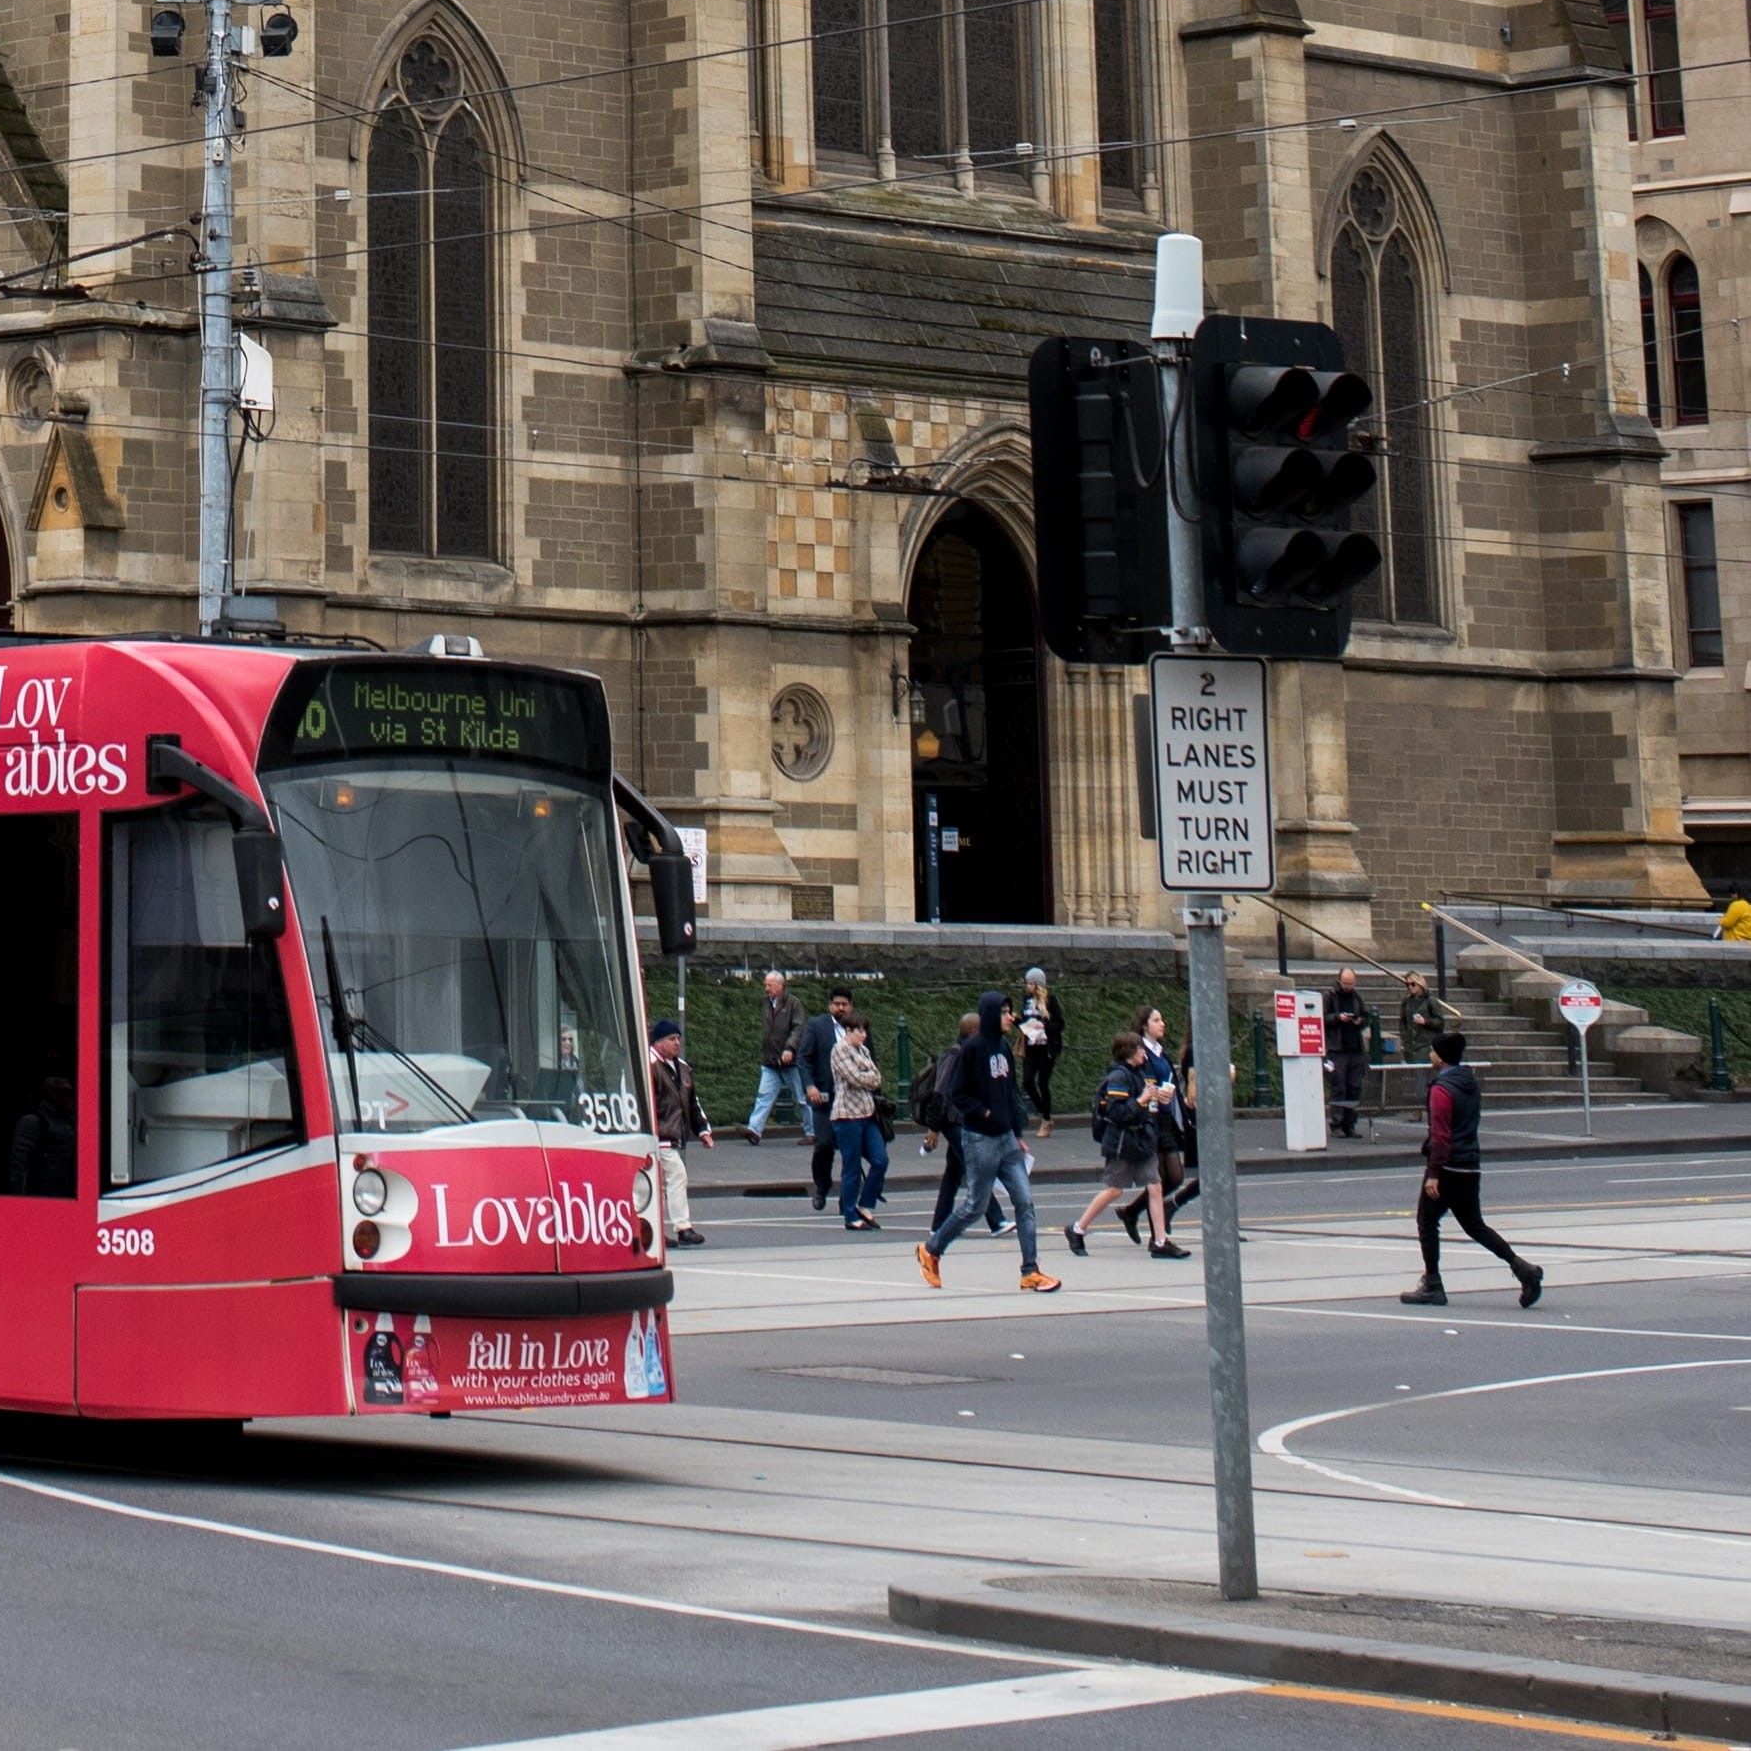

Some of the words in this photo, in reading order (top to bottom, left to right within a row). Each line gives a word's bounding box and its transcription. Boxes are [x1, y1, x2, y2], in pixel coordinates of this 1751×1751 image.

[1199, 671, 1217, 697] 2
[354, 681, 487, 715] Melbourne
[499, 691, 536, 718] Uni
[1171, 706, 1247, 732] RIGHT
[370, 716, 407, 744] via
[420, 717, 446, 745] St
[460, 719, 520, 750] Kilda
[5, 729, 128, 798] ables
[1167, 743, 1256, 768] LANES
[1177, 780, 1248, 805] MUST
[1178, 816, 1250, 842] TURN
[1178, 850, 1252, 875] RIGHT
[578, 1092, 641, 1133] 3508
[430, 1181, 634, 1247] Lovables
[96, 1228, 155, 1257] 3508
[467, 1331, 511, 1371] fall
[518, 1333, 545, 1370] in
[551, 1332, 610, 1370] Love
[451, 1372, 488, 1388] with
[491, 1376, 528, 1393] your
[530, 1370, 582, 1388] clothes
[583, 1370, 616, 1390] again
[463, 1391, 610, 1407] www.lovableslaundry.com.au
